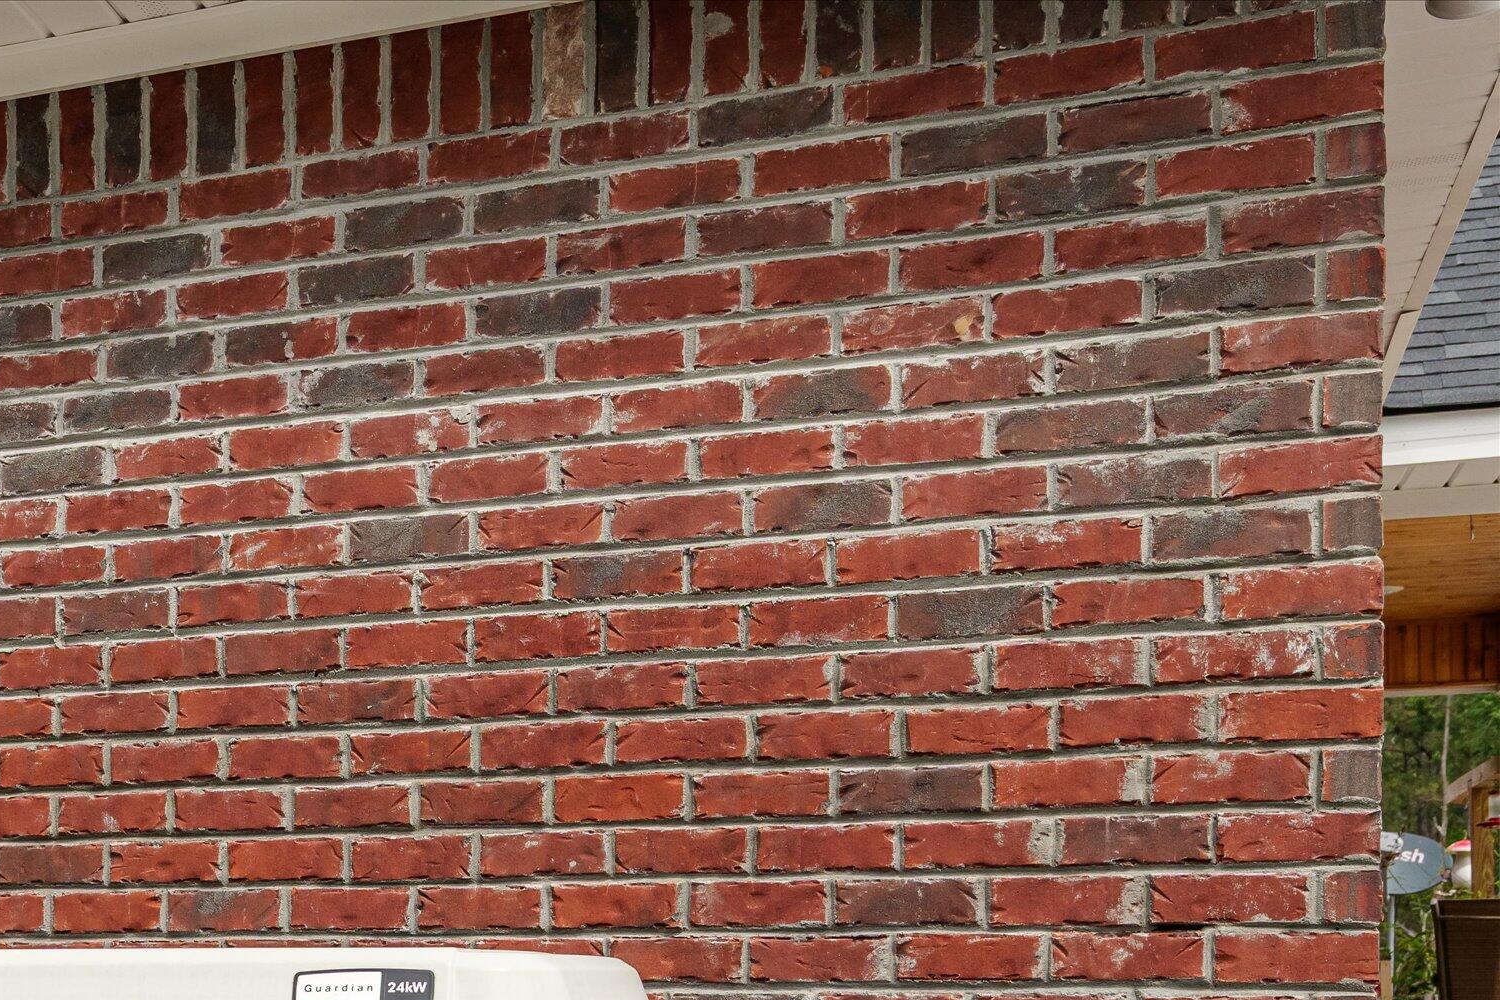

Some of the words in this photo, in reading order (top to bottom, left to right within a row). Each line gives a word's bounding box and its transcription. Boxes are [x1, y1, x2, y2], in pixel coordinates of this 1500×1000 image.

[1395, 848, 1425, 864] sh
[304, 984, 373, 993] Guardian
[387, 981, 427, 993] 24kW
